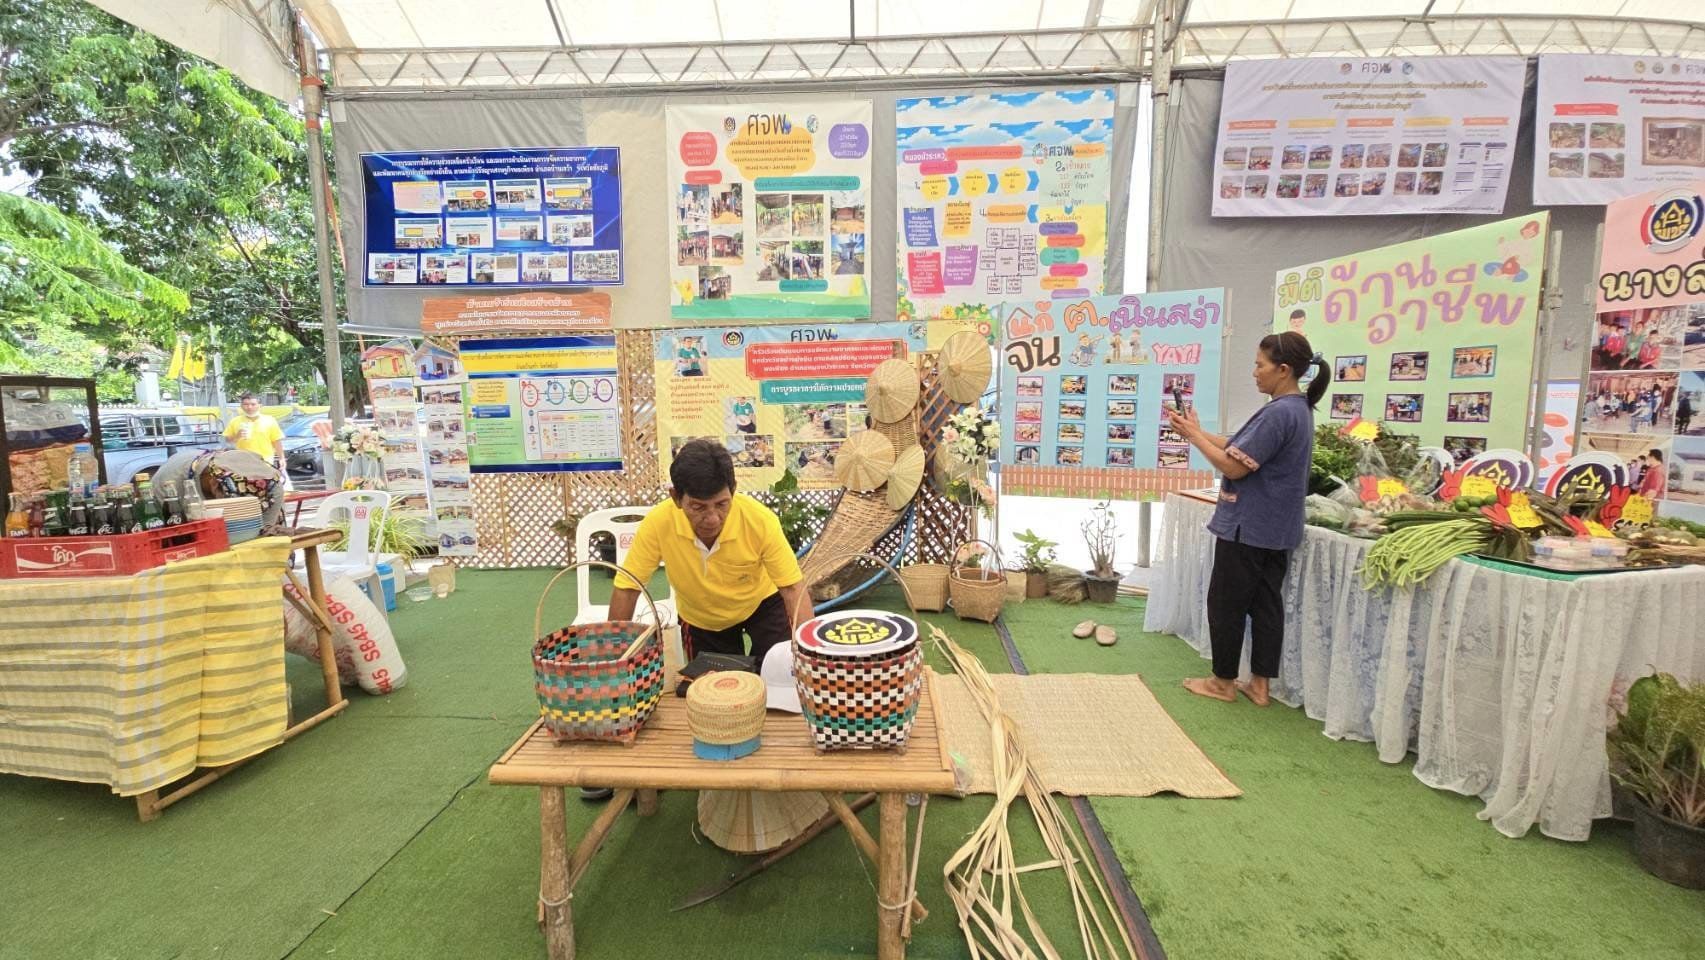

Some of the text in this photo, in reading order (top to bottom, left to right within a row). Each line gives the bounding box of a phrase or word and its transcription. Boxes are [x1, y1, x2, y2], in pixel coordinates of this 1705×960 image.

[1277, 253, 1438, 323] มิติ ด้าน
[1367, 263, 1526, 345] อาชีพ
[1005, 335, 1061, 373] จน
[1152, 342, 1202, 366] YAY!
[346, 623, 382, 662] SB45
